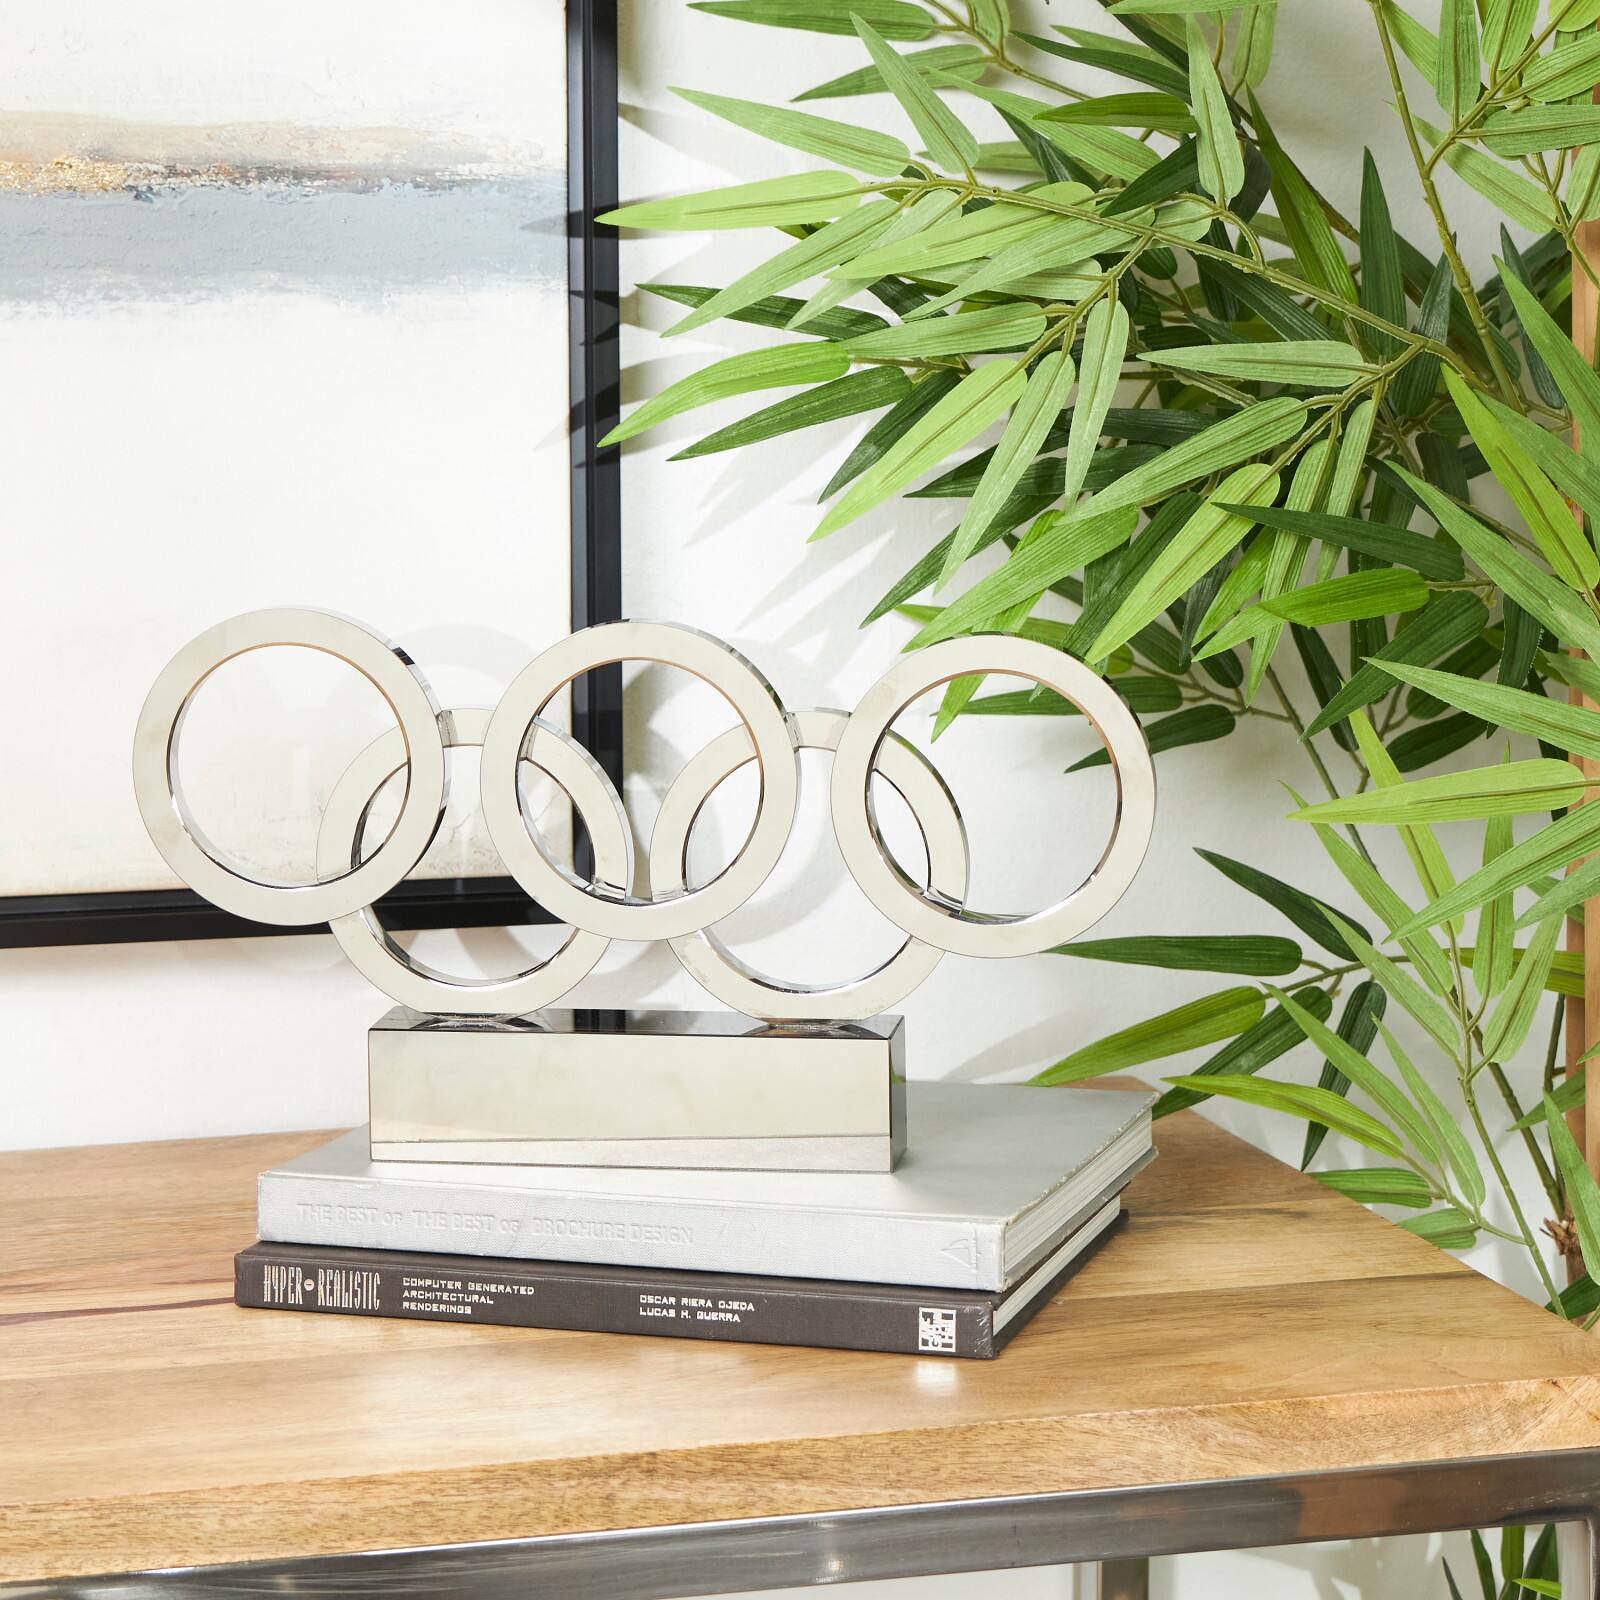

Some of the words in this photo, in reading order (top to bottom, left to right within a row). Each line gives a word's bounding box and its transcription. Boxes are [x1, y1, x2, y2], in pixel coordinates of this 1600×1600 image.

[296, 1203, 332, 1223] THE
[336, 1205, 378, 1224] BEST
[412, 1209, 449, 1229] THE
[452, 1211, 495, 1231] BEST
[532, 1216, 625, 1241] BROCHURE
[628, 1222, 694, 1245] DESIGN
[402, 1277, 462, 1290] COMPUTER
[468, 1281, 535, 1295] GENERATED
[402, 1289, 494, 1304] ARCHITECTURAL
[639, 1294, 676, 1305] OSCAR
[681, 1297, 713, 1308] RIERA
[718, 1300, 755, 1311] OJEDA
[402, 1301, 472, 1314] RENDERINGS
[639, 1307, 676, 1317] LUCAS
[697, 1311, 741, 1322] GUERRA
